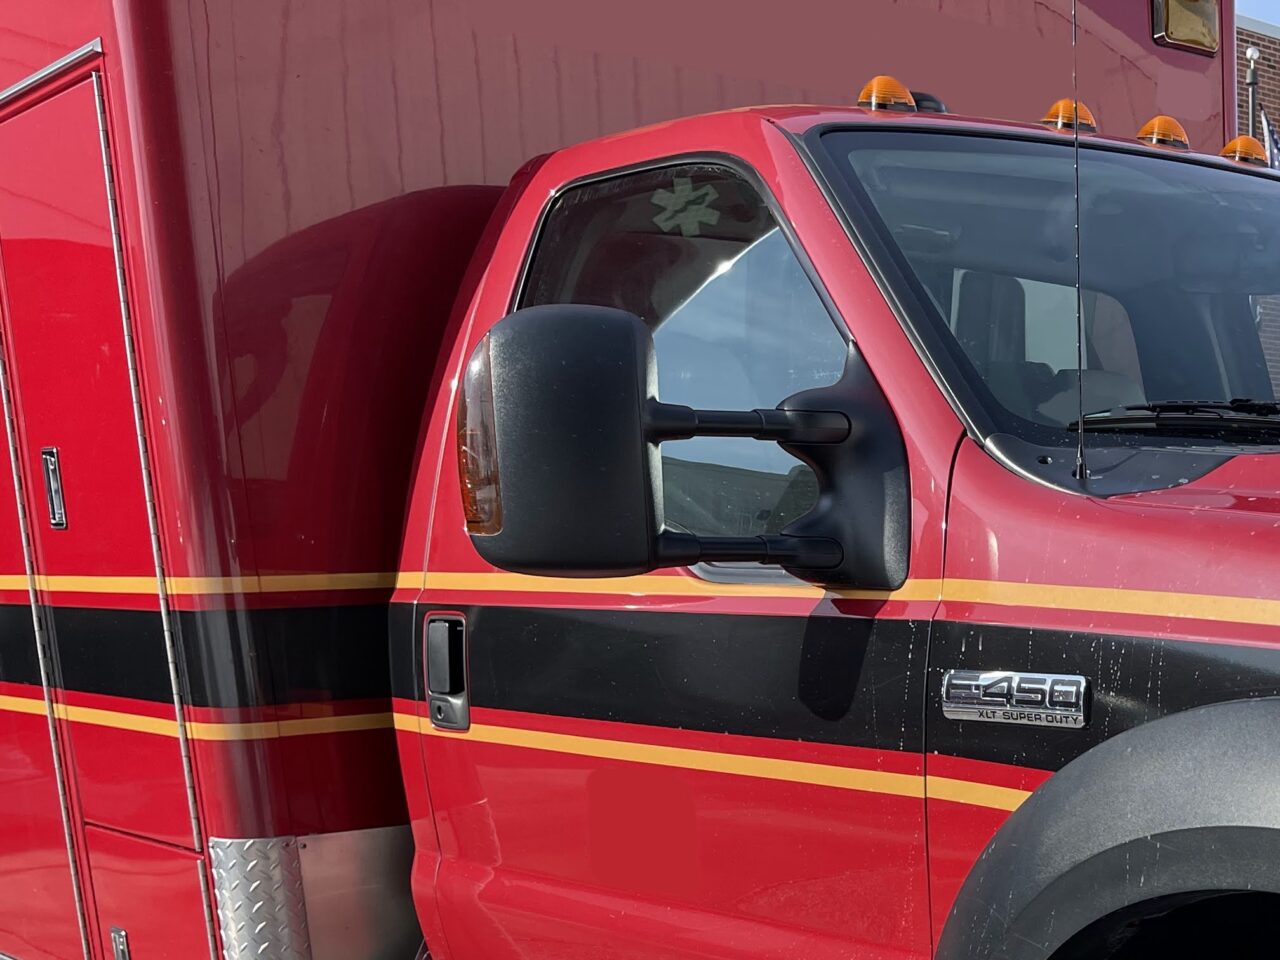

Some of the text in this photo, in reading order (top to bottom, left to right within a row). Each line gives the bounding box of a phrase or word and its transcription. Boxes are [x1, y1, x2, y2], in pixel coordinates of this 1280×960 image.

[977, 709, 1080, 725] XLT SUPER DUTY
